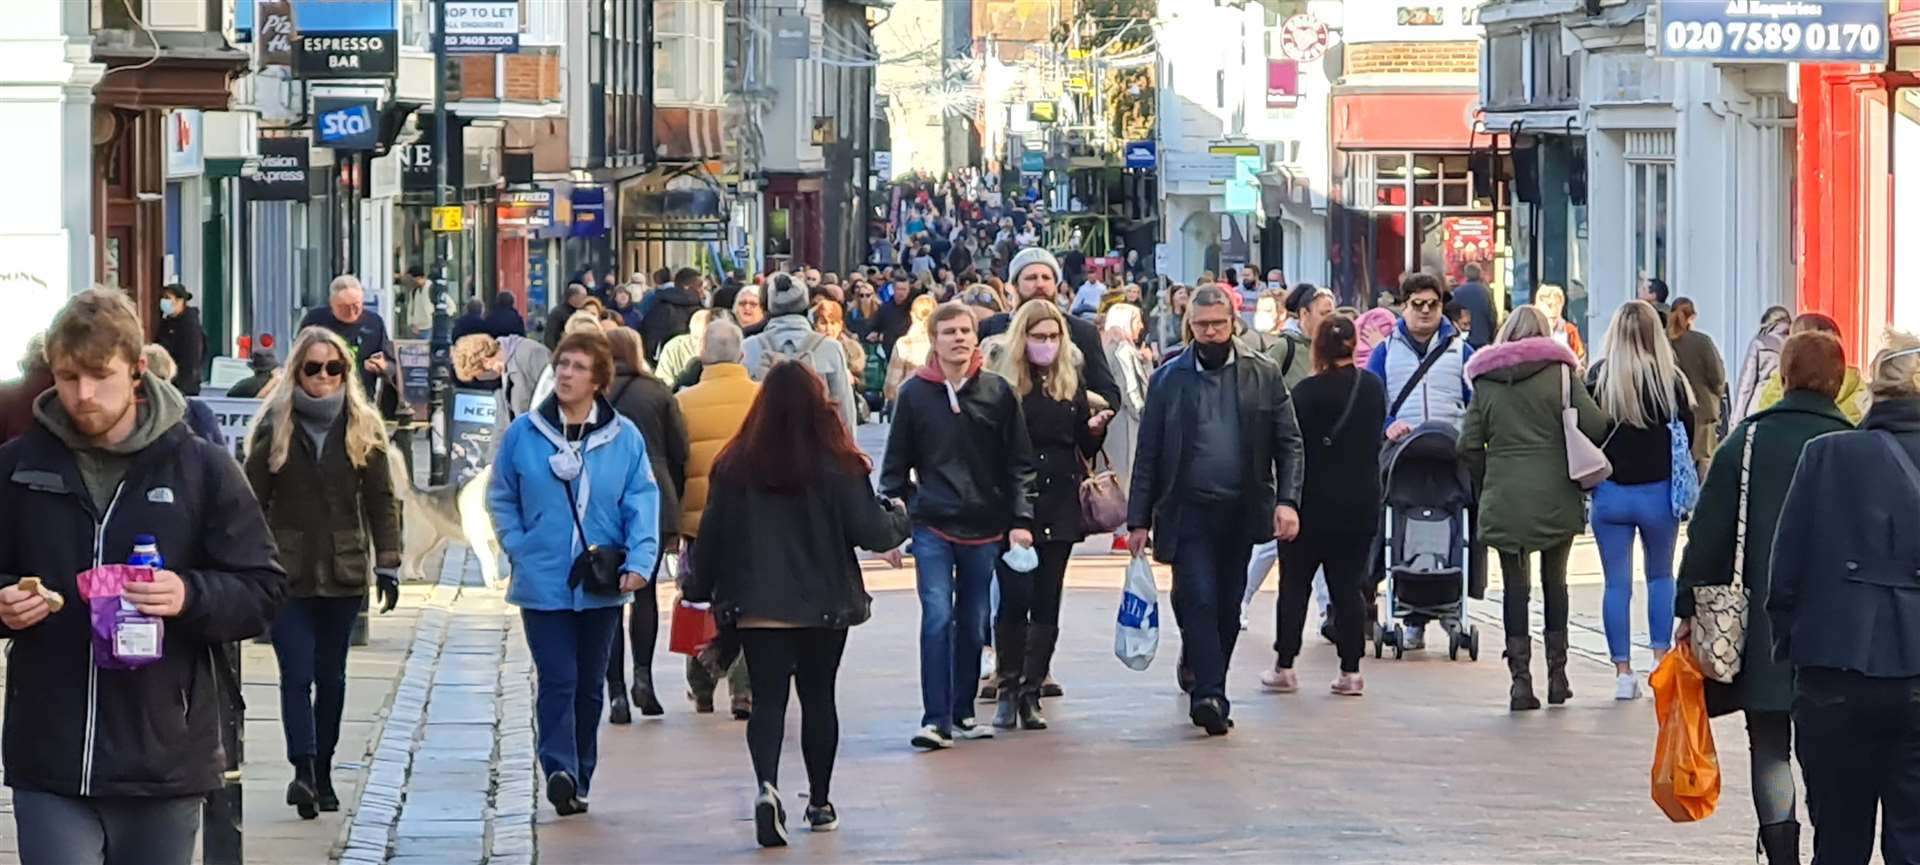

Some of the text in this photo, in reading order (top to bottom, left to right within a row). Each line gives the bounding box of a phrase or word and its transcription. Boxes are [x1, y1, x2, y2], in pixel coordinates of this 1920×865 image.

[471, 8, 487, 17] TO
[492, 8, 514, 17] LET
[1726, 0, 1749, 15] All
[262, 14, 291, 34] Piz
[303, 36, 383, 51] ESPRESSO
[445, 36, 458, 45] 20
[1666, 21, 1880, 53] 020 7589 0170
[328, 55, 359, 68] BAR
[259, 154, 298, 167] vision
[252, 169, 305, 184] express
[463, 404, 496, 417] NER
